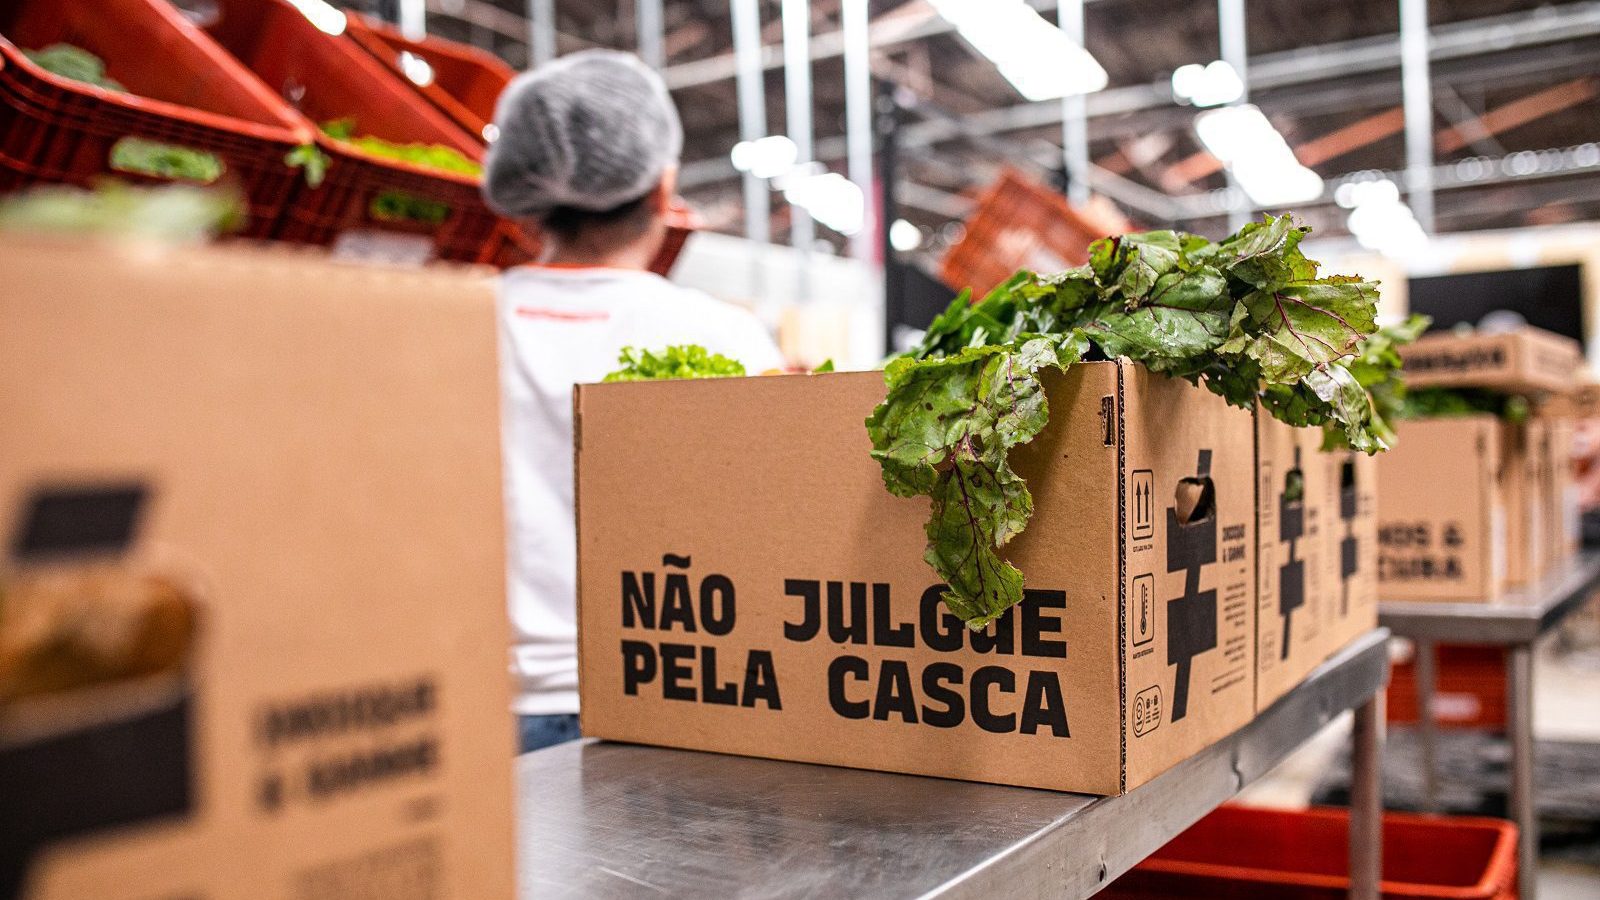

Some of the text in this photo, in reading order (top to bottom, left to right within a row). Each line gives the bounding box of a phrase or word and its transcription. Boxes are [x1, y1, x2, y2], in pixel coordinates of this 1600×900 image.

[621, 553, 736, 636] NÃO
[621, 640, 783, 711] PELA
[828, 655, 1071, 738] CASCA
